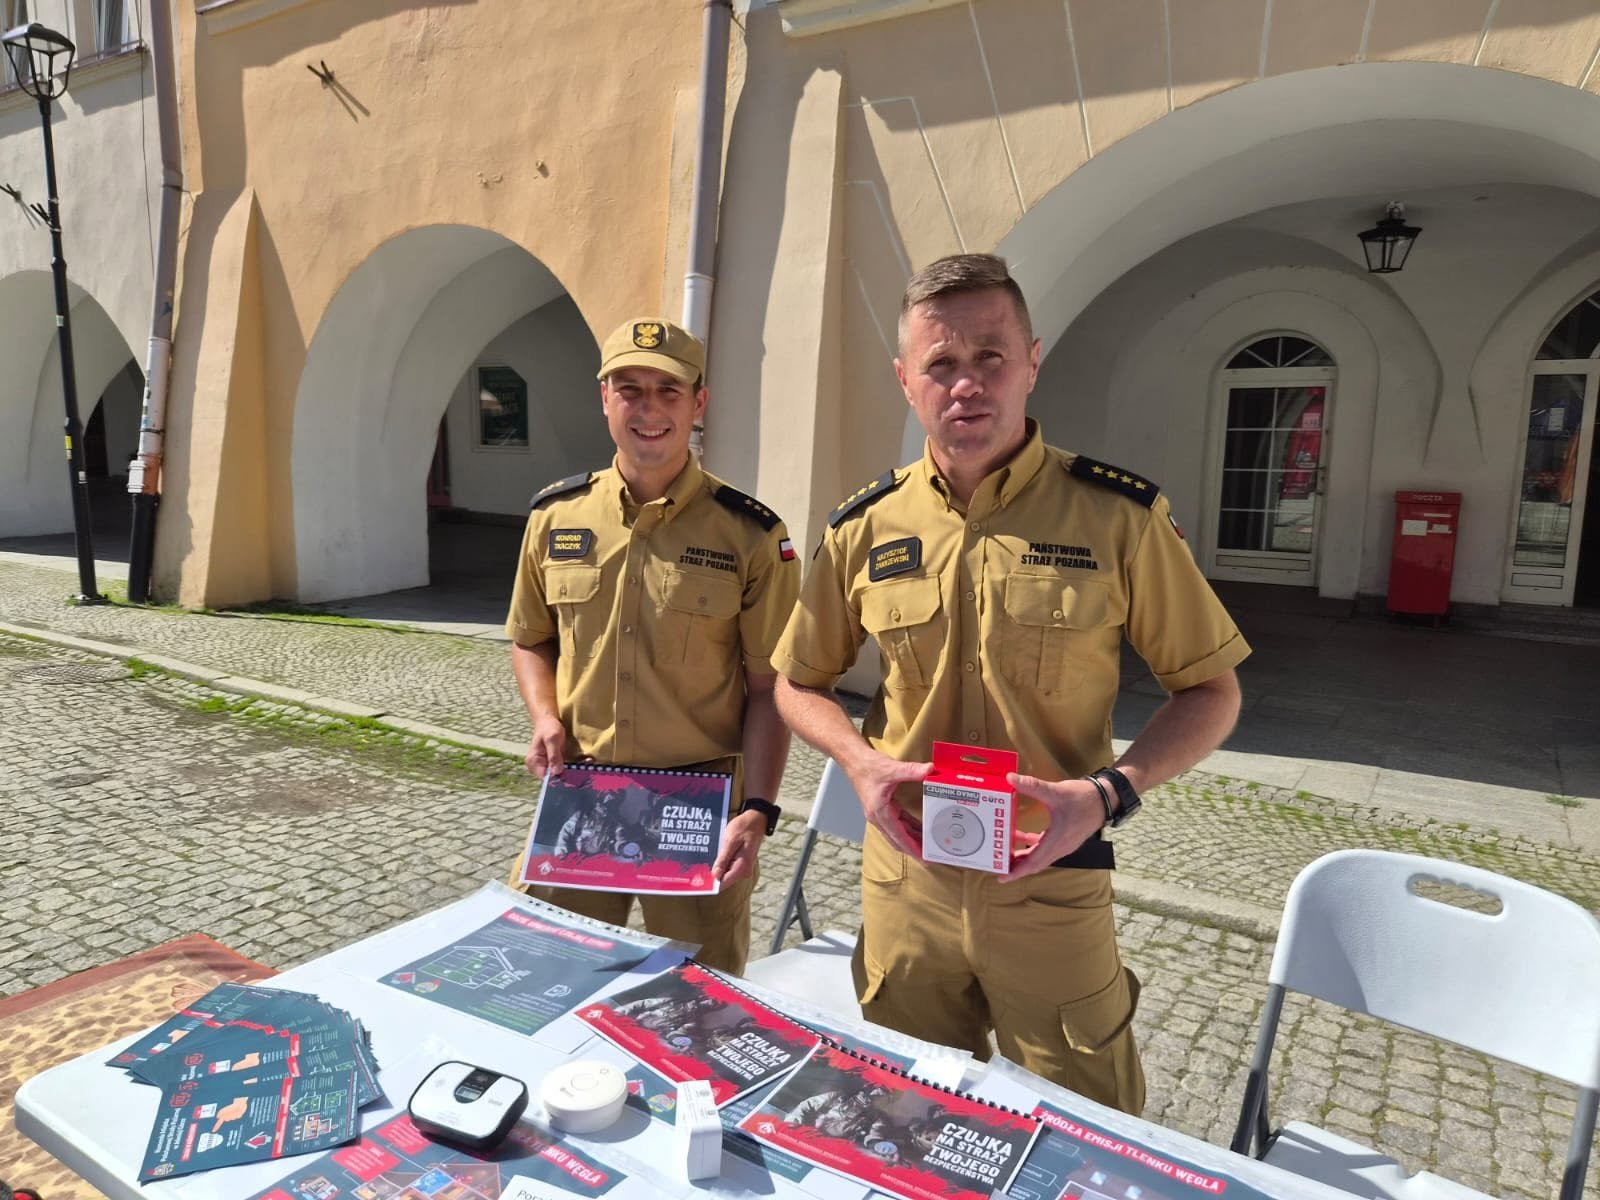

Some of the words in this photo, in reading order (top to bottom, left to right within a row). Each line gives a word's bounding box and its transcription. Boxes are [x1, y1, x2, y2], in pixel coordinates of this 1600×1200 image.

[1029, 541, 1092, 558] PAŃSTWOWA
[956, 789, 979, 799] DYMU
[661, 818, 674, 829] NA
[676, 819, 712, 831] STRAŻY
[662, 805, 713, 821] CZUJKA
[660, 832, 710, 846] TWOJEGO
[715, 1044, 766, 1076] TWOJEGO
[728, 1038, 746, 1049] NA
[742, 1045, 780, 1068] STRAŻY
[740, 1032, 792, 1064] CZUJKA
[936, 1133, 955, 1147] NA
[956, 1141, 1009, 1165] STRAŻY
[942, 1122, 1013, 1157] CZUJKA
[1040, 1110, 1083, 1137] ŹRÓDŁA
[1083, 1131, 1123, 1153] EMISJI
[1124, 1146, 1174, 1173] TLENKU
[1175, 1168, 1220, 1190] WĘGLA
[564, 1158, 601, 1183] WĘGLA
[922, 1154, 995, 1186] BEZPIECZEŃSTWA
[929, 1144, 1001, 1178] TWOJEGO
